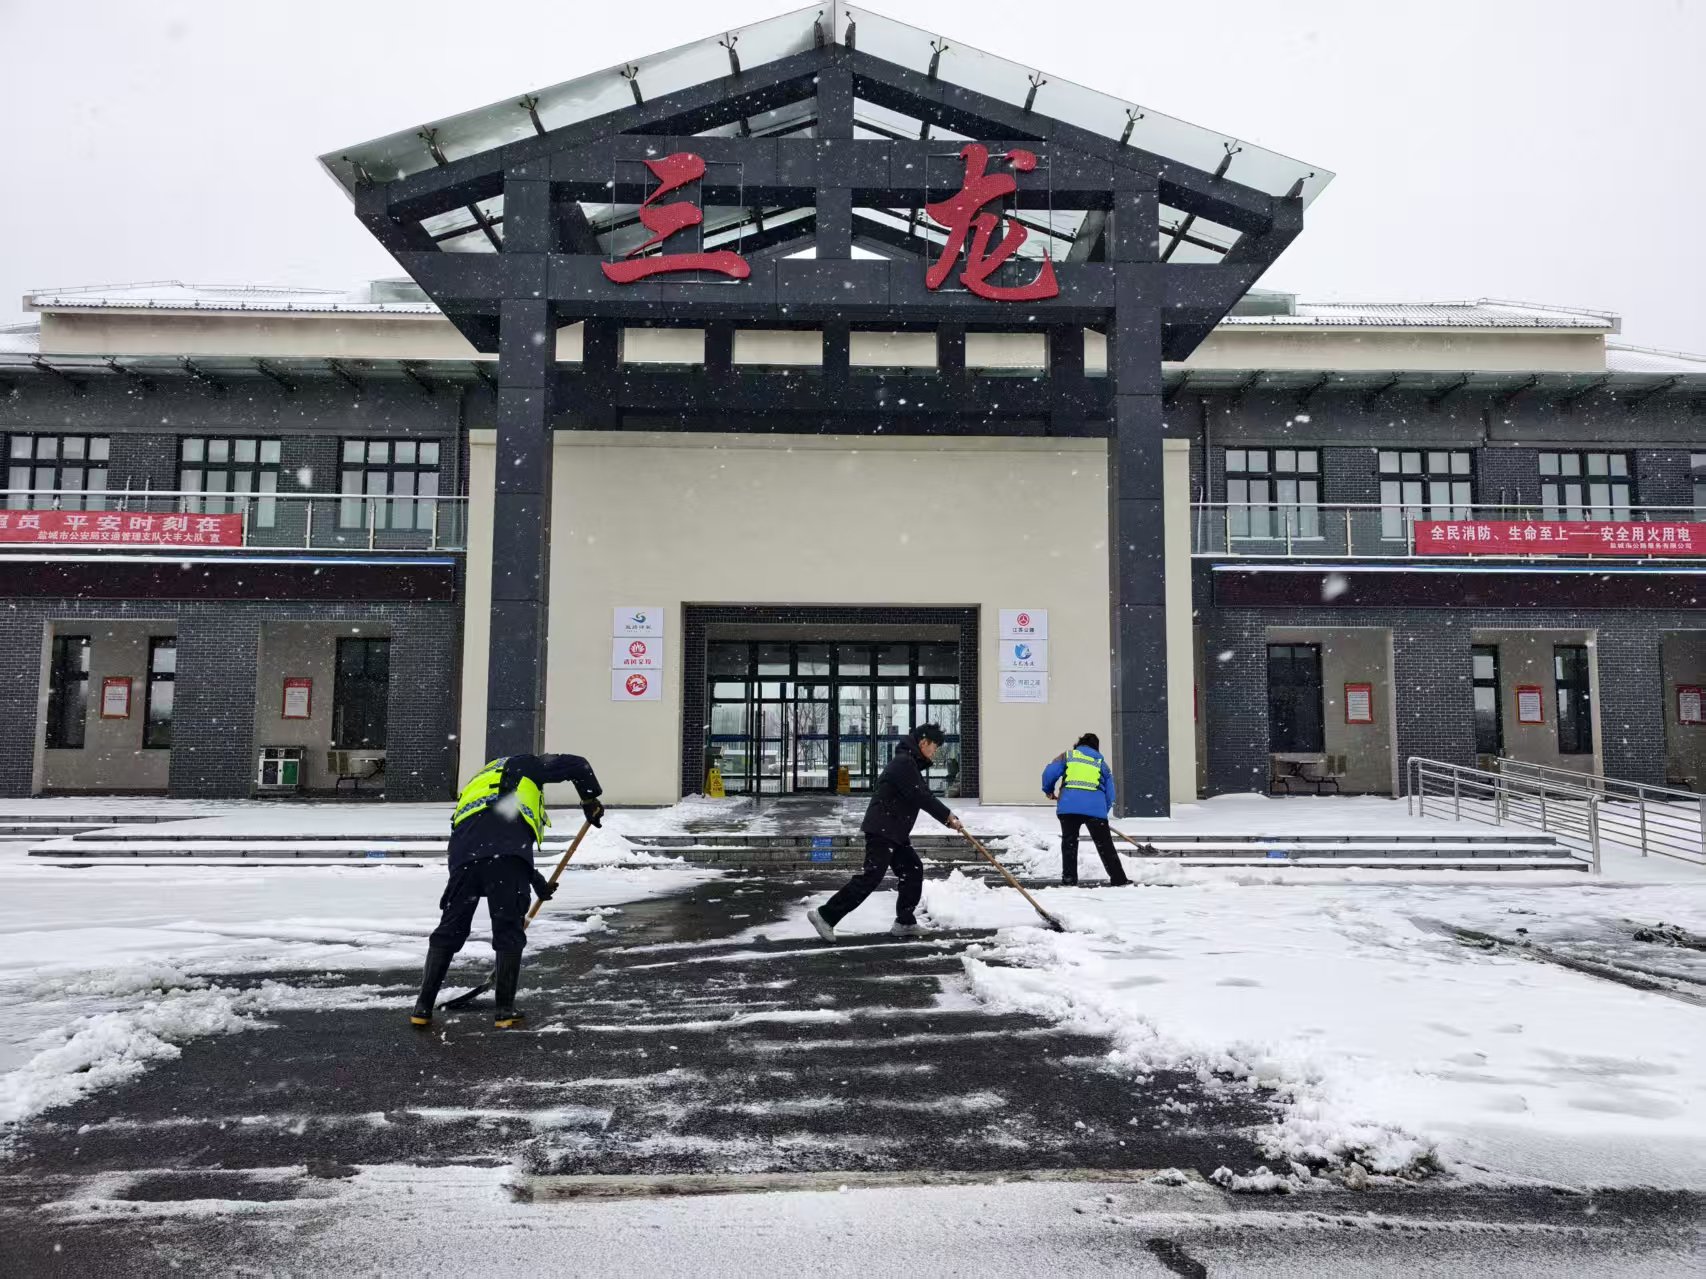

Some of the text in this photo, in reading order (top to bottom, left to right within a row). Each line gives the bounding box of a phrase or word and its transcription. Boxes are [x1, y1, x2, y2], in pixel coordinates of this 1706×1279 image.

[600, 143, 1059, 302] 三龙
[63, 515, 221, 533] 平安时刻在
